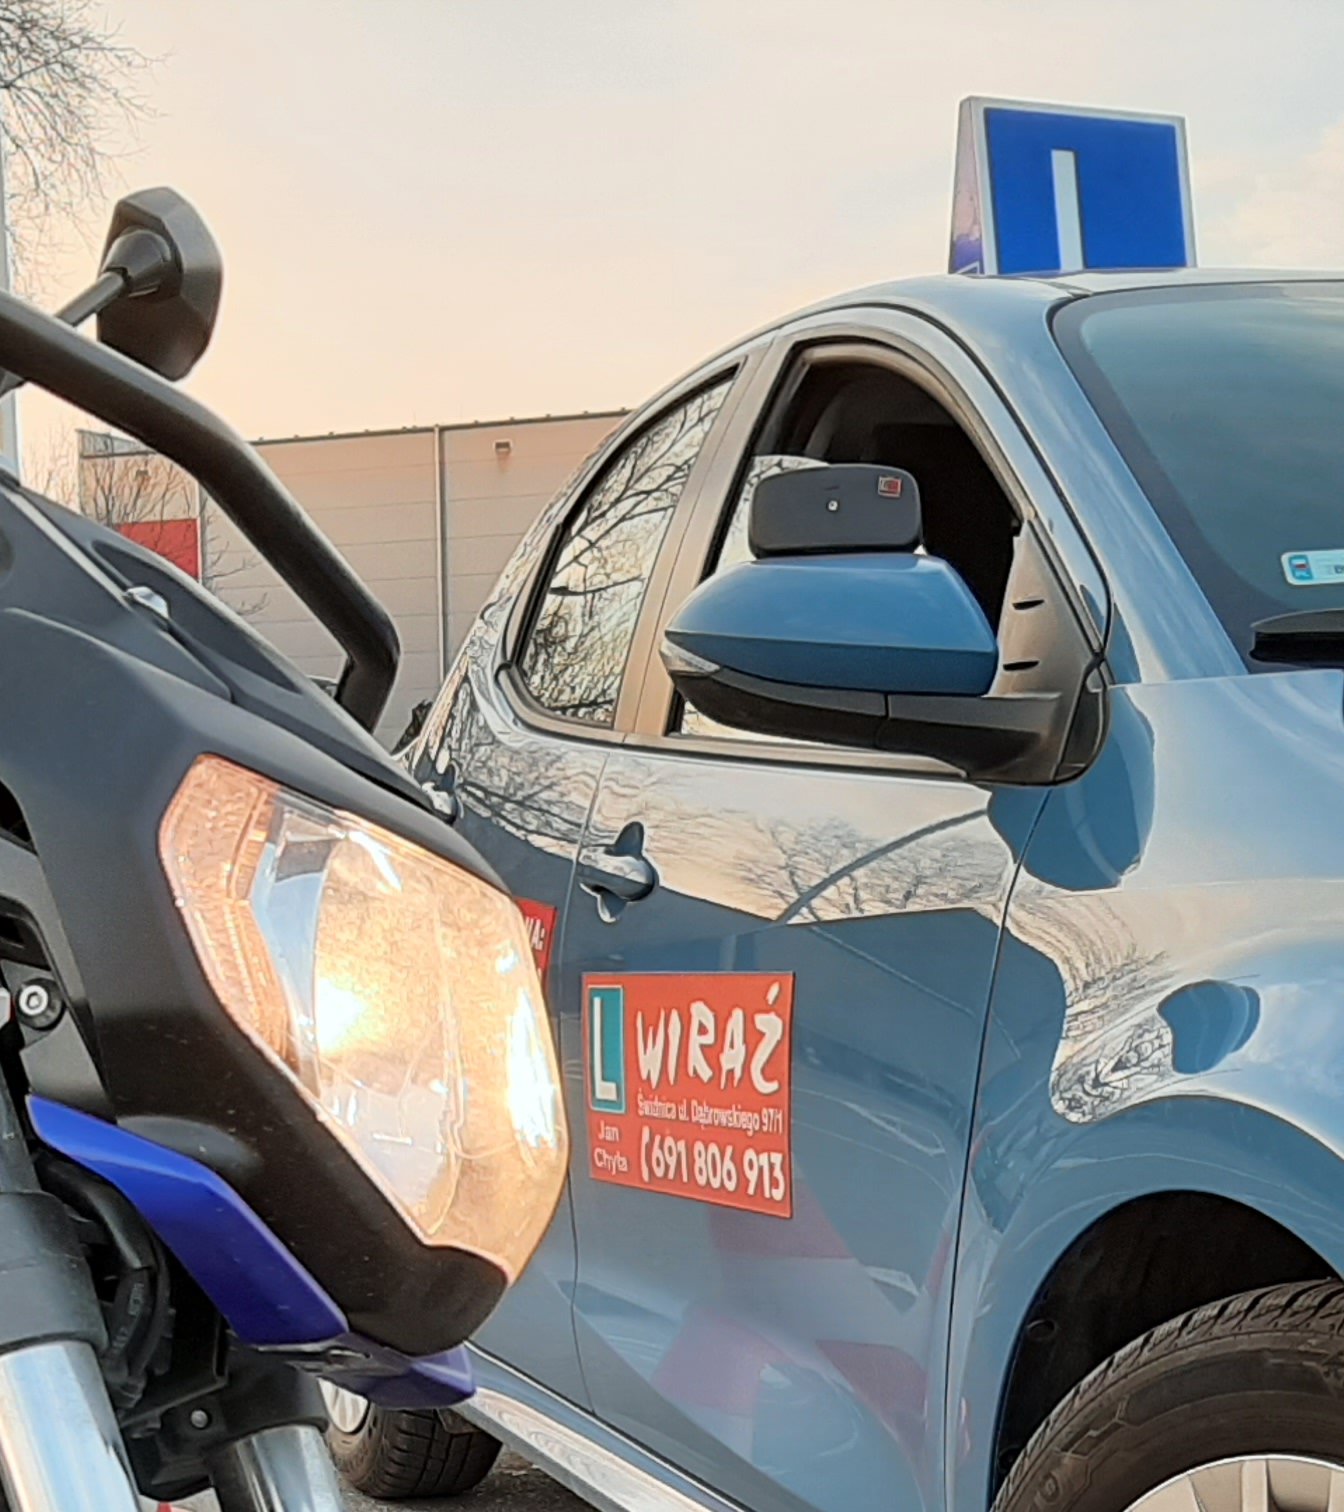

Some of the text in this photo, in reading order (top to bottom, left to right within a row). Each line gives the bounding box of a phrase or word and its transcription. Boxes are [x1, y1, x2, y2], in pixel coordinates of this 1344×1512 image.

[593, 997, 618, 1101] L
[598, 1120, 620, 1142] Jan
[652, 1133, 785, 1201] 691 806 913
